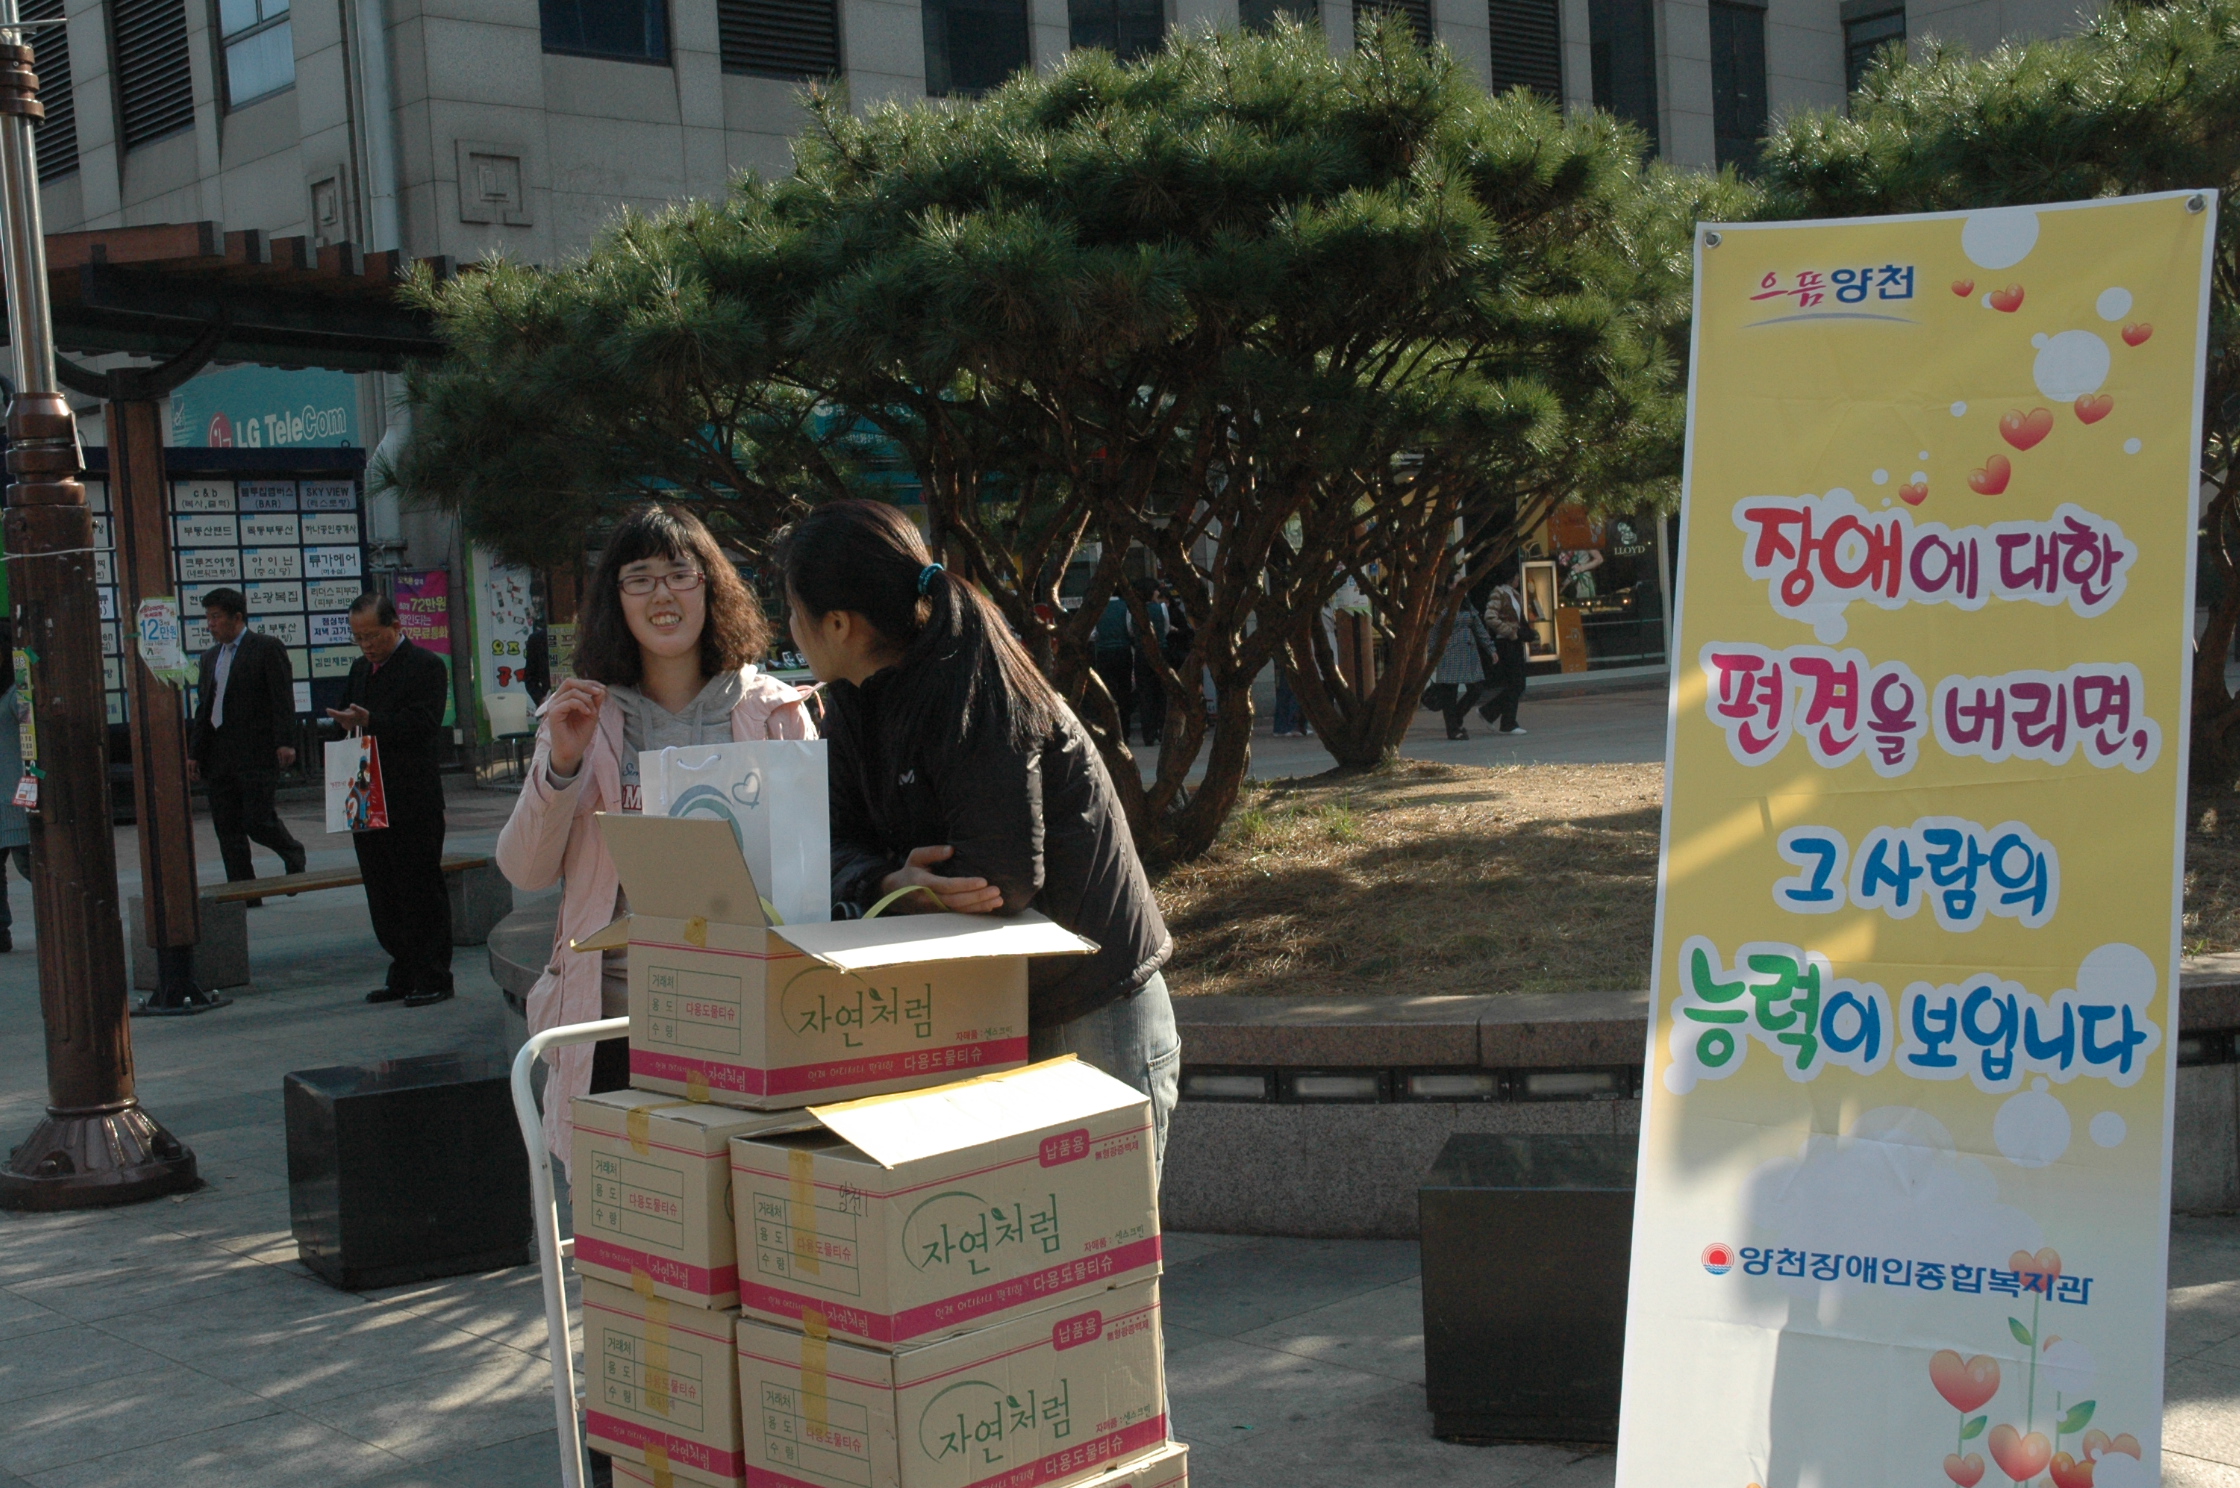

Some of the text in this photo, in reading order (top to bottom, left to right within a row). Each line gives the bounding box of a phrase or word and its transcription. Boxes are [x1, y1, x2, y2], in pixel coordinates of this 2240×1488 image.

[236, 404, 347, 447] LG TeleCom
[306, 487, 349, 497] SKY VIEW
[1613, 545, 1646, 556] LLOYD
[1744, 504, 2124, 608] 장애에 대한
[1711, 652, 2149, 766] 편견을 버리면,
[1785, 827, 2048, 920] 그 사람의
[686, 1002, 735, 1021] 다용도물티슈
[798, 984, 932, 1048] 자연처럼
[1683, 947, 2149, 1082] 능력이 보입니다
[904, 1046, 982, 1072] 다용도물티슈
[1044, 1135, 1086, 1161] 납품용
[629, 1193, 678, 1217] 다용도물티슈
[796, 1237, 851, 1262] 다용도물티슈
[921, 1193, 1061, 1276] 자연처럼
[1033, 1258, 1114, 1292] 다용도물티슈
[1738, 1246, 2093, 1306] 양천장애인종합복지관
[1058, 1317, 1097, 1344] 납품용
[938, 1378, 1071, 1464] 자연처럼
[1045, 1435, 1124, 1475] 다용도물티슈
